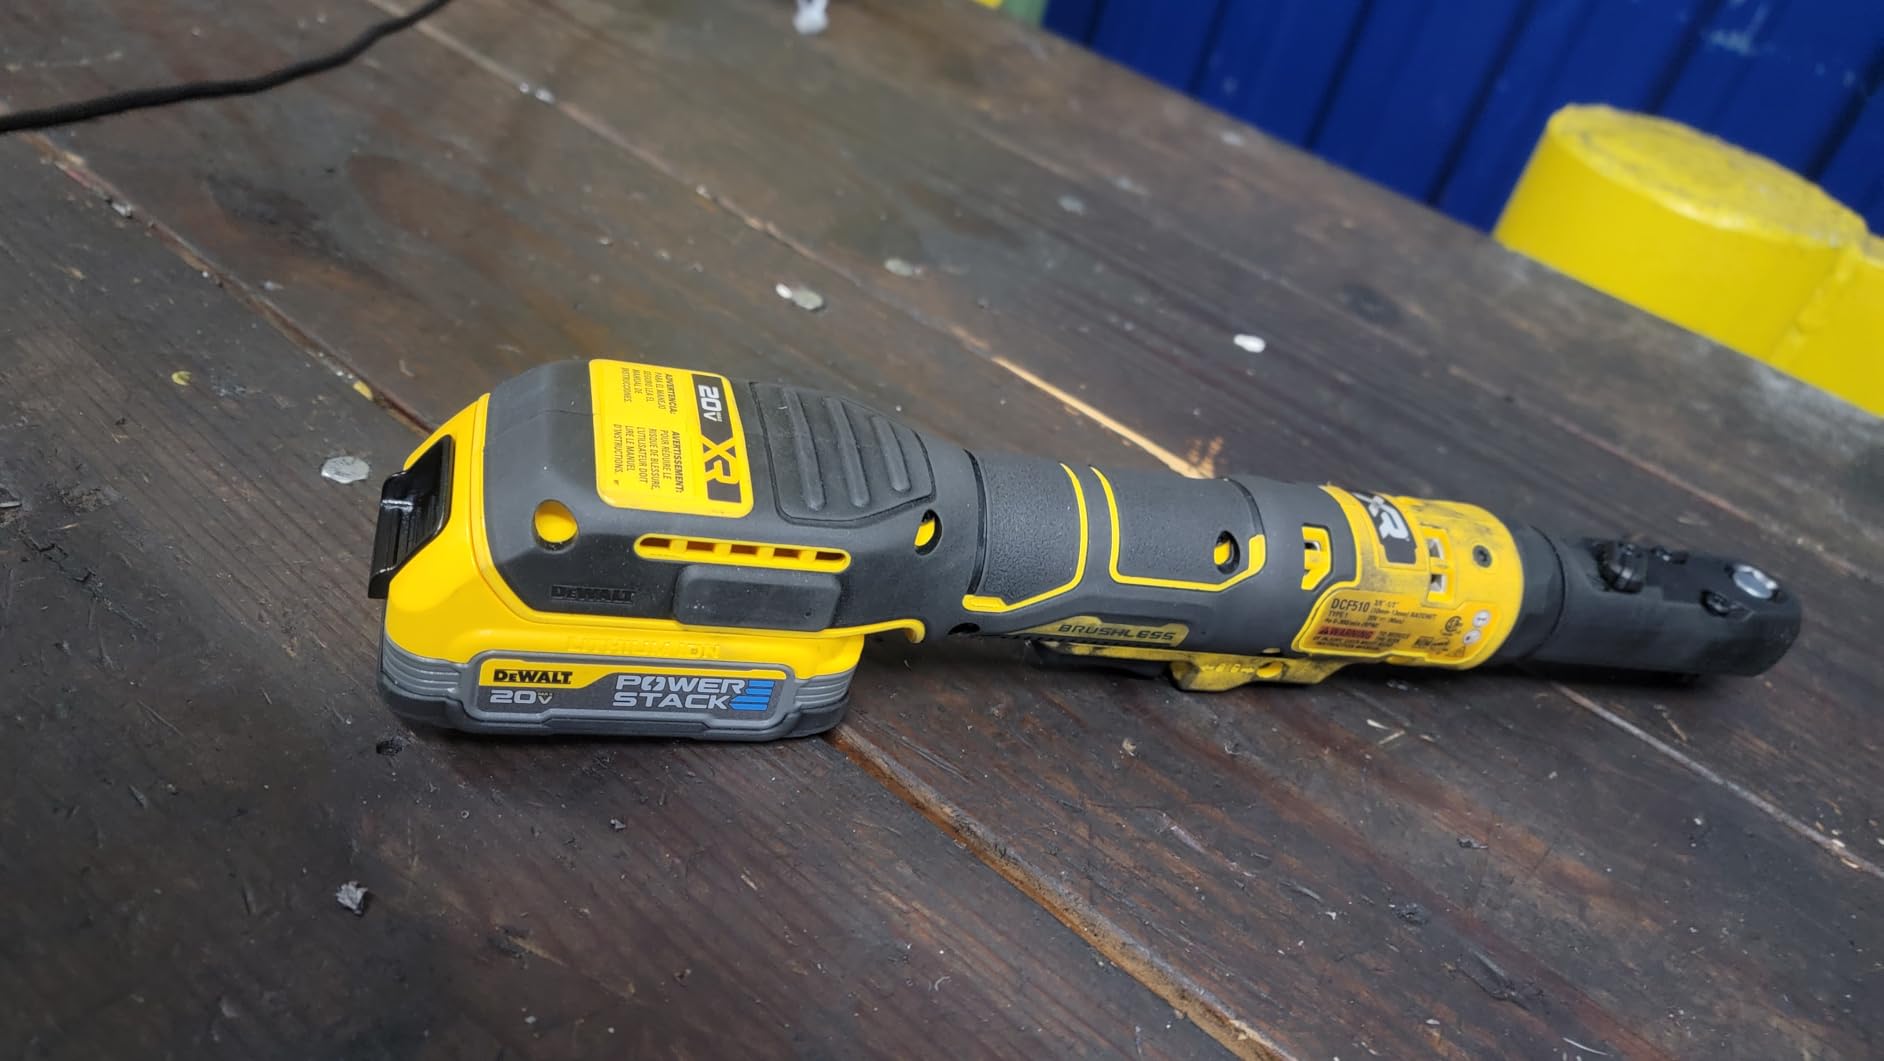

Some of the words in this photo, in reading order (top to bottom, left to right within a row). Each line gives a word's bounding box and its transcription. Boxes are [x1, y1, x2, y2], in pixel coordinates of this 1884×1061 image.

[666, 374, 677, 415] ADVERTENCIA:
[698, 384, 722, 422] 20V
[625, 426, 634, 437] LIRE
[649, 428, 658, 448] RISQUE
[660, 430, 669, 445] POUR
[626, 446, 635, 471] MANUEL
[650, 449, 658, 457] DE
[701, 435, 738, 484] XR
[672, 431, 684, 493] AVERTISSEMENT:
[639, 468, 648, 484] DOIT
[663, 472, 671, 480] LE
[1330, 598, 1370, 613] DCF510
[1058, 624, 1176, 641] BRUSHLESS
[493, 668, 573, 685] DEWALT
[616, 674, 746, 694] POWER
[490, 689, 553, 704] 20V
[612, 691, 731, 710] STACK
